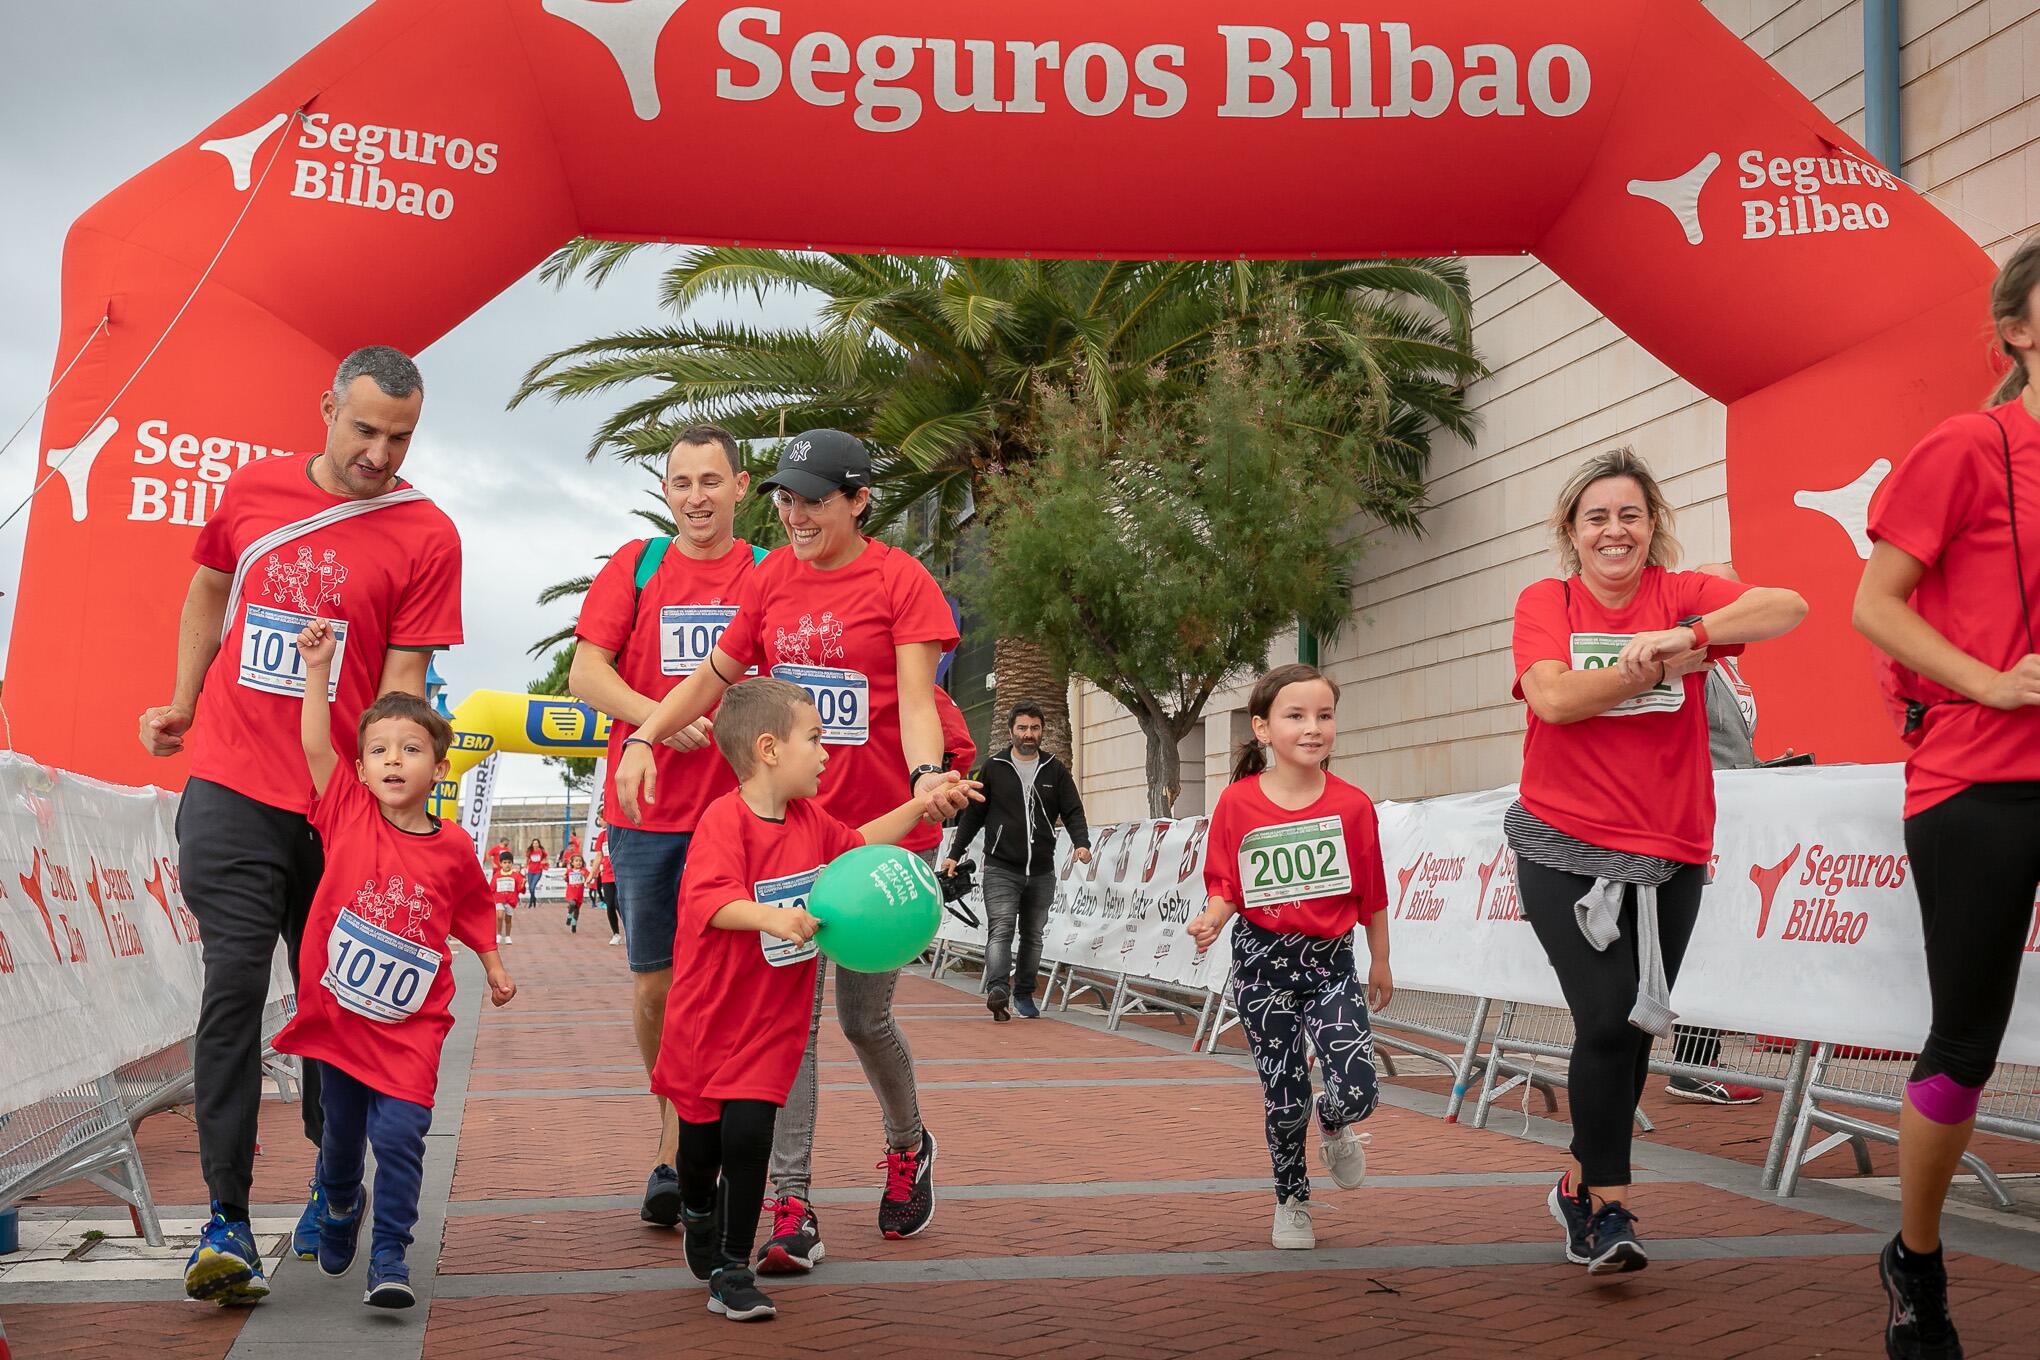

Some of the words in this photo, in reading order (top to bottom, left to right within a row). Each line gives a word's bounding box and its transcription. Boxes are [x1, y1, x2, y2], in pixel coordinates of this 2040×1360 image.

[716, 6, 1188, 133] Seguros
[1217, 21, 1591, 119] Bilbao
[298, 112, 499, 175] Seguros
[290, 159, 455, 221] Bilbao
[1738, 150, 1898, 193] Seguros
[1742, 195, 1889, 239] Bilbao
[134, 419, 294, 483] Segu
[127, 476, 225, 527] Bil
[251, 630, 301, 674] 101
[462, 734, 490, 750] BM
[470, 757, 491, 827] CORRE
[877, 862, 908, 905] BIZKAIA
[888, 858, 919, 900] retina
[1250, 840, 1340, 887] 2002
[1419, 852, 1466, 888] Seguros
[1800, 844, 1908, 896] Seguros
[1070, 886, 1097, 917] Getxo
[1157, 889, 1191, 925] Getxo
[1405, 890, 1445, 921] Bilbao
[1488, 886, 1520, 921] Bilb
[1781, 898, 1868, 945] Bilbao
[336, 939, 420, 1007] 1010
